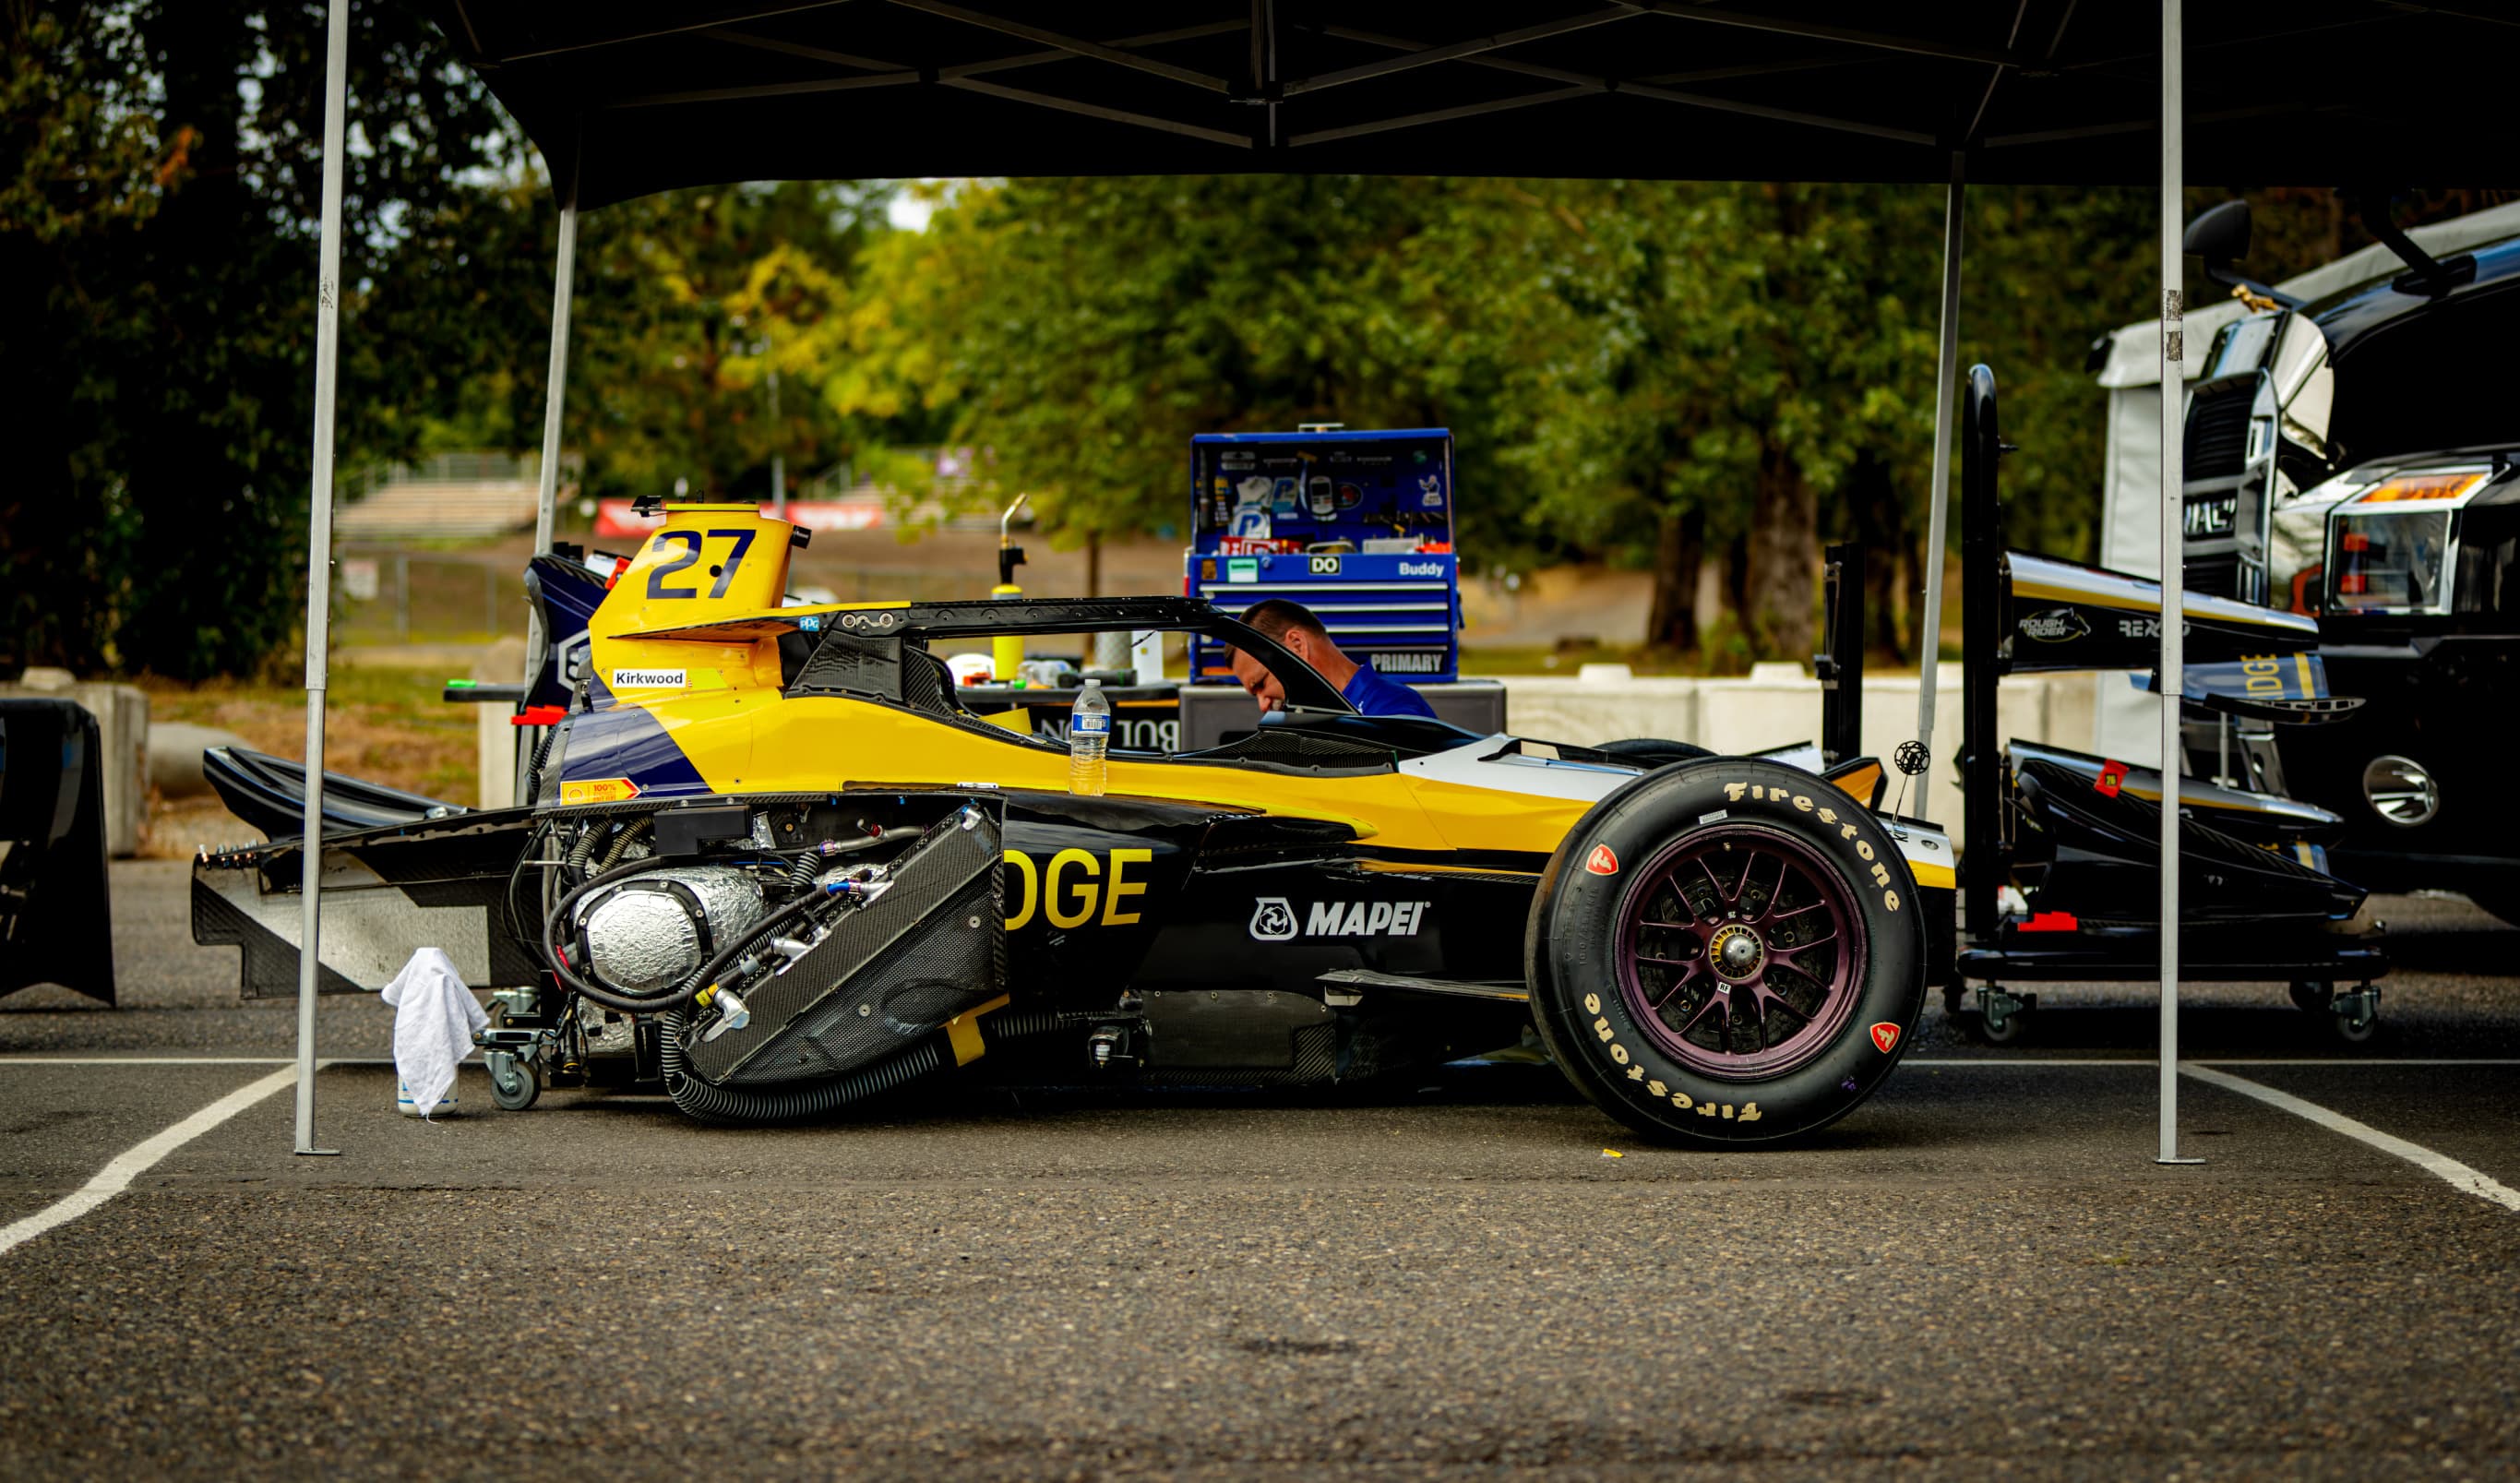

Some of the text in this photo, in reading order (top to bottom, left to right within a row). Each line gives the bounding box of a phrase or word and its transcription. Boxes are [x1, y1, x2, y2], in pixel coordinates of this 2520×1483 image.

[646, 529, 757, 600] 27
[1311, 557, 1338, 572] DO
[1399, 562, 1444, 577] Buddy
[2019, 618, 2064, 628] ROUGH
[2027, 628, 2067, 637] RIDER
[1370, 653, 1442, 672] PRIMARY
[615, 672, 684, 685] Kirkwood
[2239, 653, 2286, 700] IDGE
[593, 783, 617, 792] 100%
[1723, 782, 1901, 912] Firestone
[1305, 902, 1425, 936] MAPEI
[1719, 983, 1730, 992] RF
[1583, 992, 1762, 1122] Firestone
